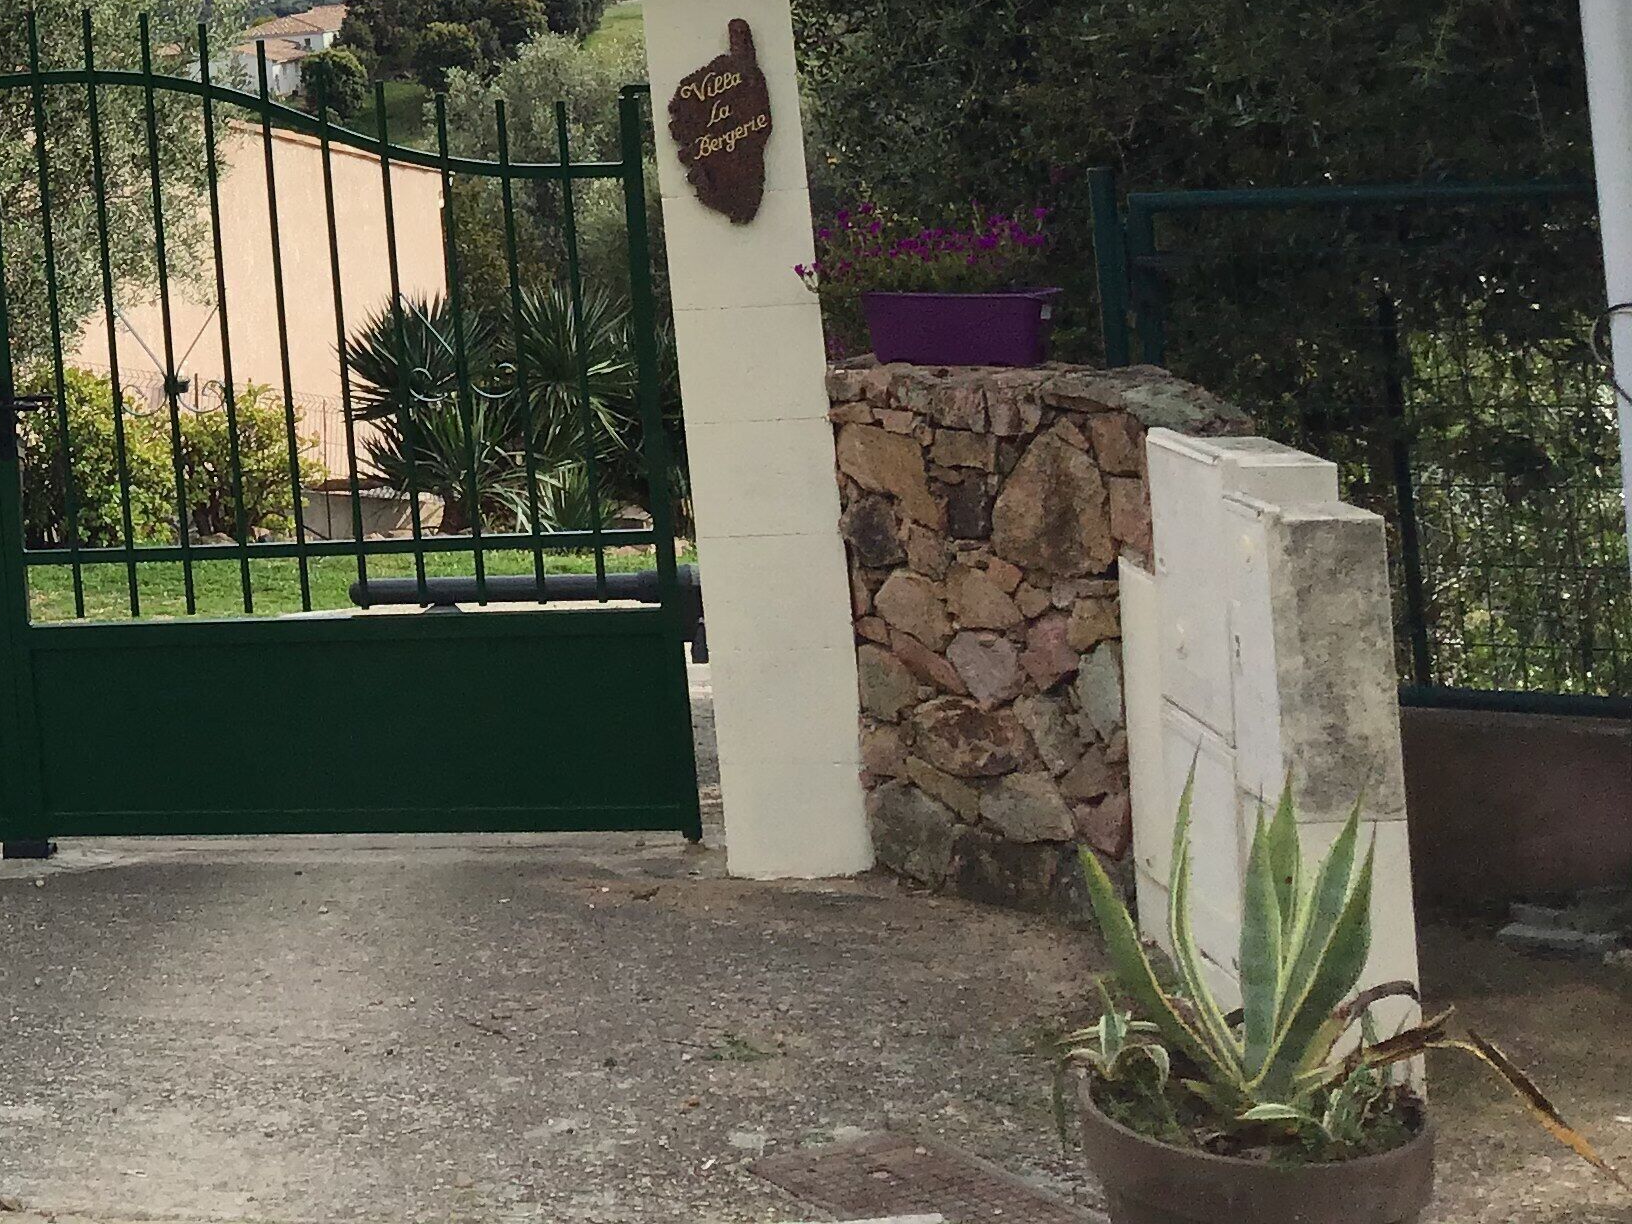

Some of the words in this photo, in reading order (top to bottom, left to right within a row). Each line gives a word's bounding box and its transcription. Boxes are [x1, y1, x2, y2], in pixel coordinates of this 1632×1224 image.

[681, 72, 742, 101] Villa
[707, 100, 731, 128] La
[694, 114, 768, 160] Bergerie
